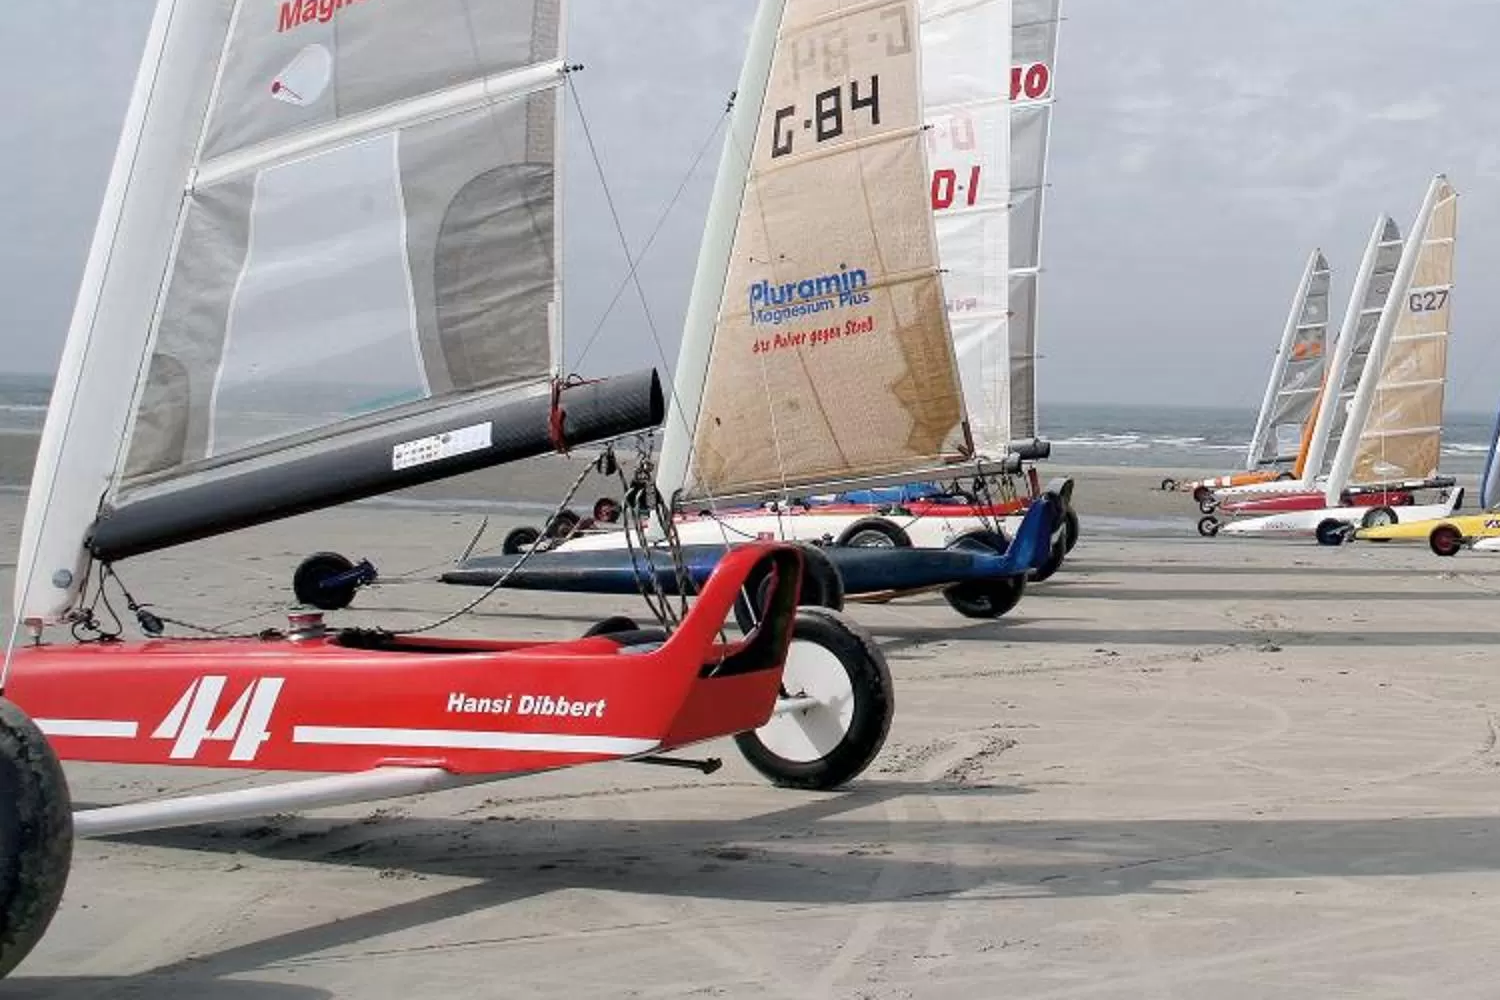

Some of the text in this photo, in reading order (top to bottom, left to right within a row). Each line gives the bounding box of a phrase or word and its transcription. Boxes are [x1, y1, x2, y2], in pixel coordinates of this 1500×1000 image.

[750, 264, 867, 311] Pluramin
[1409, 289, 1449, 312] G27
[751, 289, 870, 325] Magnesium Plus
[152, 675, 285, 761] 44
[447, 691, 606, 719] Hansi Dibbert
